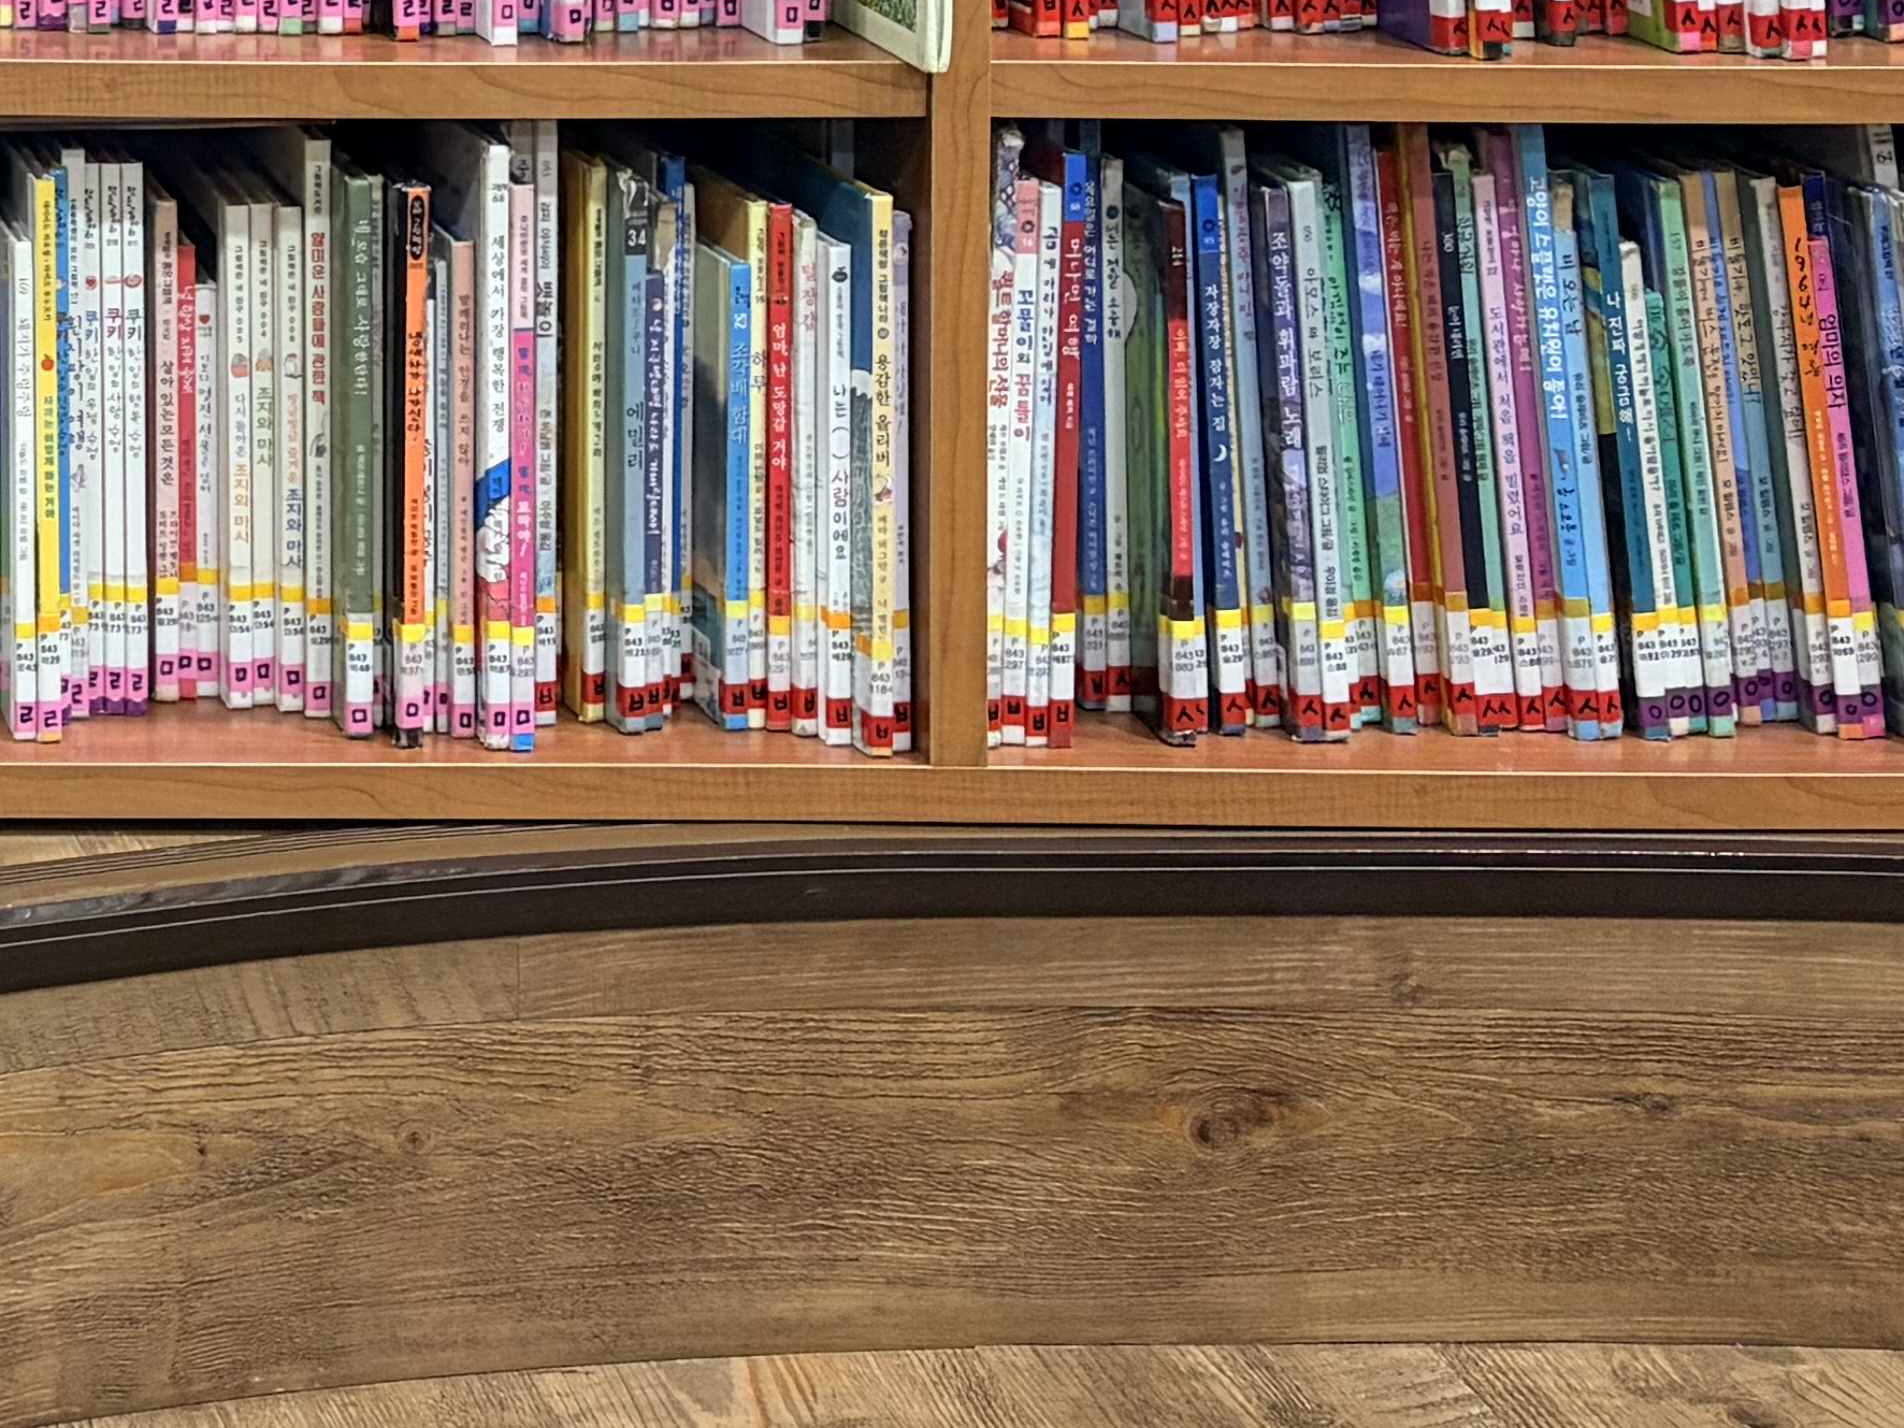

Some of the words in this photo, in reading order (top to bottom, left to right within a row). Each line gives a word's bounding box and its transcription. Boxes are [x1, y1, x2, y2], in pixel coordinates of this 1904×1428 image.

[627, 229, 647, 247] 34
[1202, 283, 1223, 350] 자장자장
[772, 363, 787, 379] 난
[876, 353, 892, 409] 용감한
[1206, 355, 1227, 411] 잠자는
[624, 401, 645, 471] 에밀리
[771, 385, 788, 435] 도망갈
[1210, 413, 1229, 433] 집
[772, 439, 788, 471] 거야
[874, 413, 892, 469] 올리버
